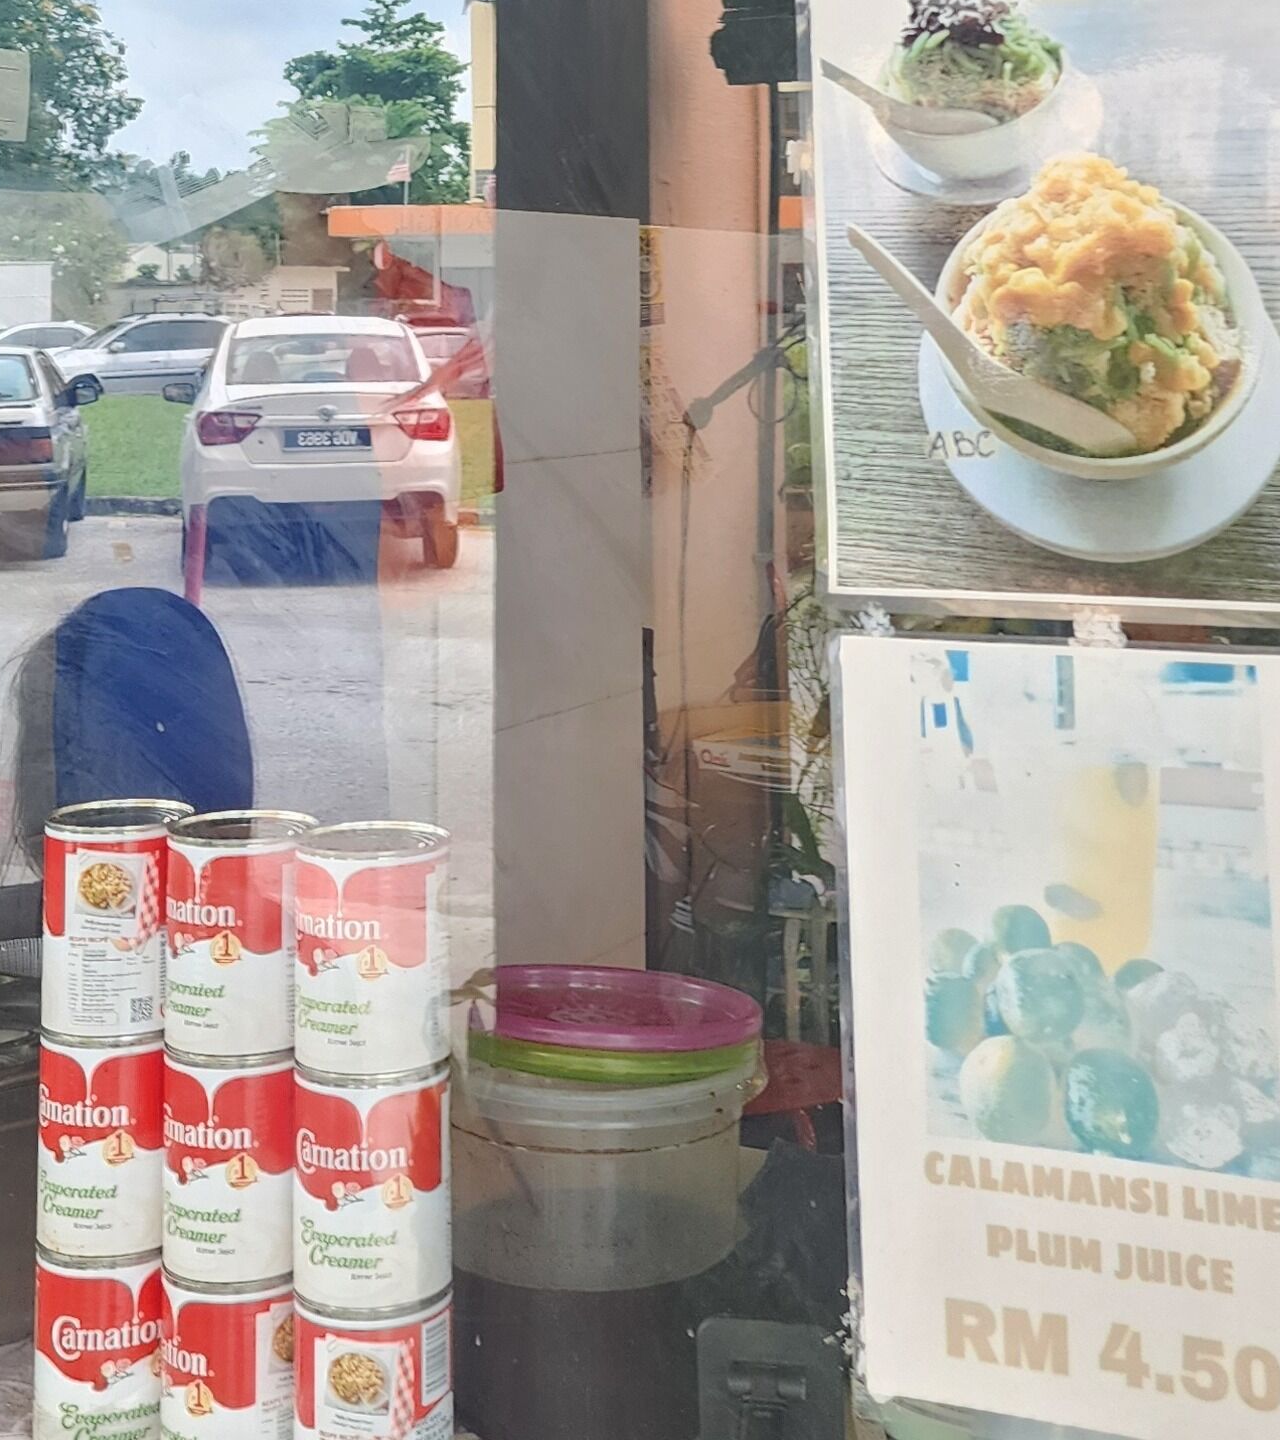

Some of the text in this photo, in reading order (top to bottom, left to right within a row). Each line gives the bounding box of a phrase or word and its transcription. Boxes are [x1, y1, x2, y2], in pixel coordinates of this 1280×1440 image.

[925, 430, 998, 459] ABC
[296, 1126, 407, 1175] Carnation
[923, 1150, 1170, 1217] CALAMANSI
[308, 1244, 384, 1270] Creamer
[984, 1224, 1236, 1295] PLUM JUICE
[943, 1297, 1070, 1377] RM
